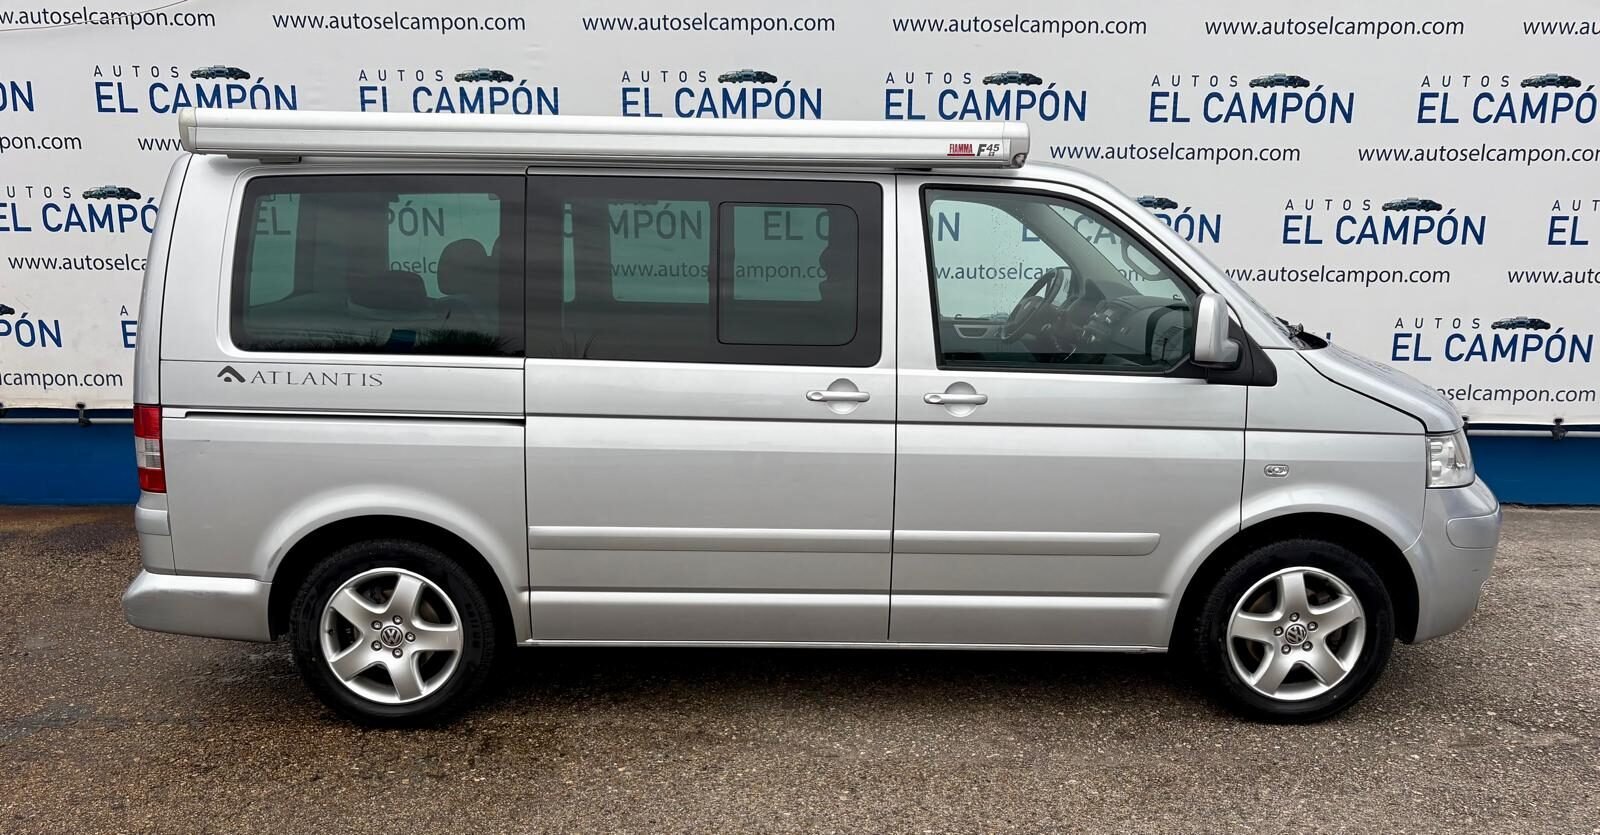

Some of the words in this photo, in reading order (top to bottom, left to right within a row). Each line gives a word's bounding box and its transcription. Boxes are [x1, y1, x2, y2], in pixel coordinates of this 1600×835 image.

[272, 11, 526, 35] www.autoselcampon.com
[582, 12, 835, 36] www.autoselcampon.com
[892, 14, 1147, 39] www.autoselcampon.com
[1205, 16, 1464, 40] www.autoselcampon.com
[94, 65, 179, 78] AUTOS
[358, 70, 443, 82] AUTOS
[621, 71, 707, 83] AUTOS
[886, 72, 972, 85] AUTOS
[1151, 75, 1238, 88] AUTOS
[1421, 75, 1509, 88] AUTOS
[95, 82, 138, 113] EL
[150, 77, 298, 113] CAMPÓN
[412, 79, 559, 115] CAMPÓN
[621, 88, 663, 118] EL
[675, 81, 822, 120] CAMPÓN
[885, 89, 926, 121] EL
[938, 83, 1087, 122] CAMPÓN
[1149, 91, 1191, 123] EL
[1203, 85, 1354, 124] CAMPÓN
[1417, 93, 1460, 124] EL
[1472, 85, 1598, 124] CAMPÓ
[949, 143, 974, 154] FIAMMA
[1049, 142, 1301, 165] www.autoselcampon.com
[7, 186, 72, 199] UTOS
[1285, 199, 1371, 211] AUTOS
[764, 211, 804, 241] EL
[1282, 214, 1323, 245] EL
[1336, 208, 1486, 245] CAMPÓN
[1548, 215, 1589, 246] EL
[1395, 317, 1480, 330] AUTOS
[1391, 332, 1431, 362] EL
[1445, 327, 1594, 363] CAMPÓN
[250, 370, 383, 387] ATLANTIS
